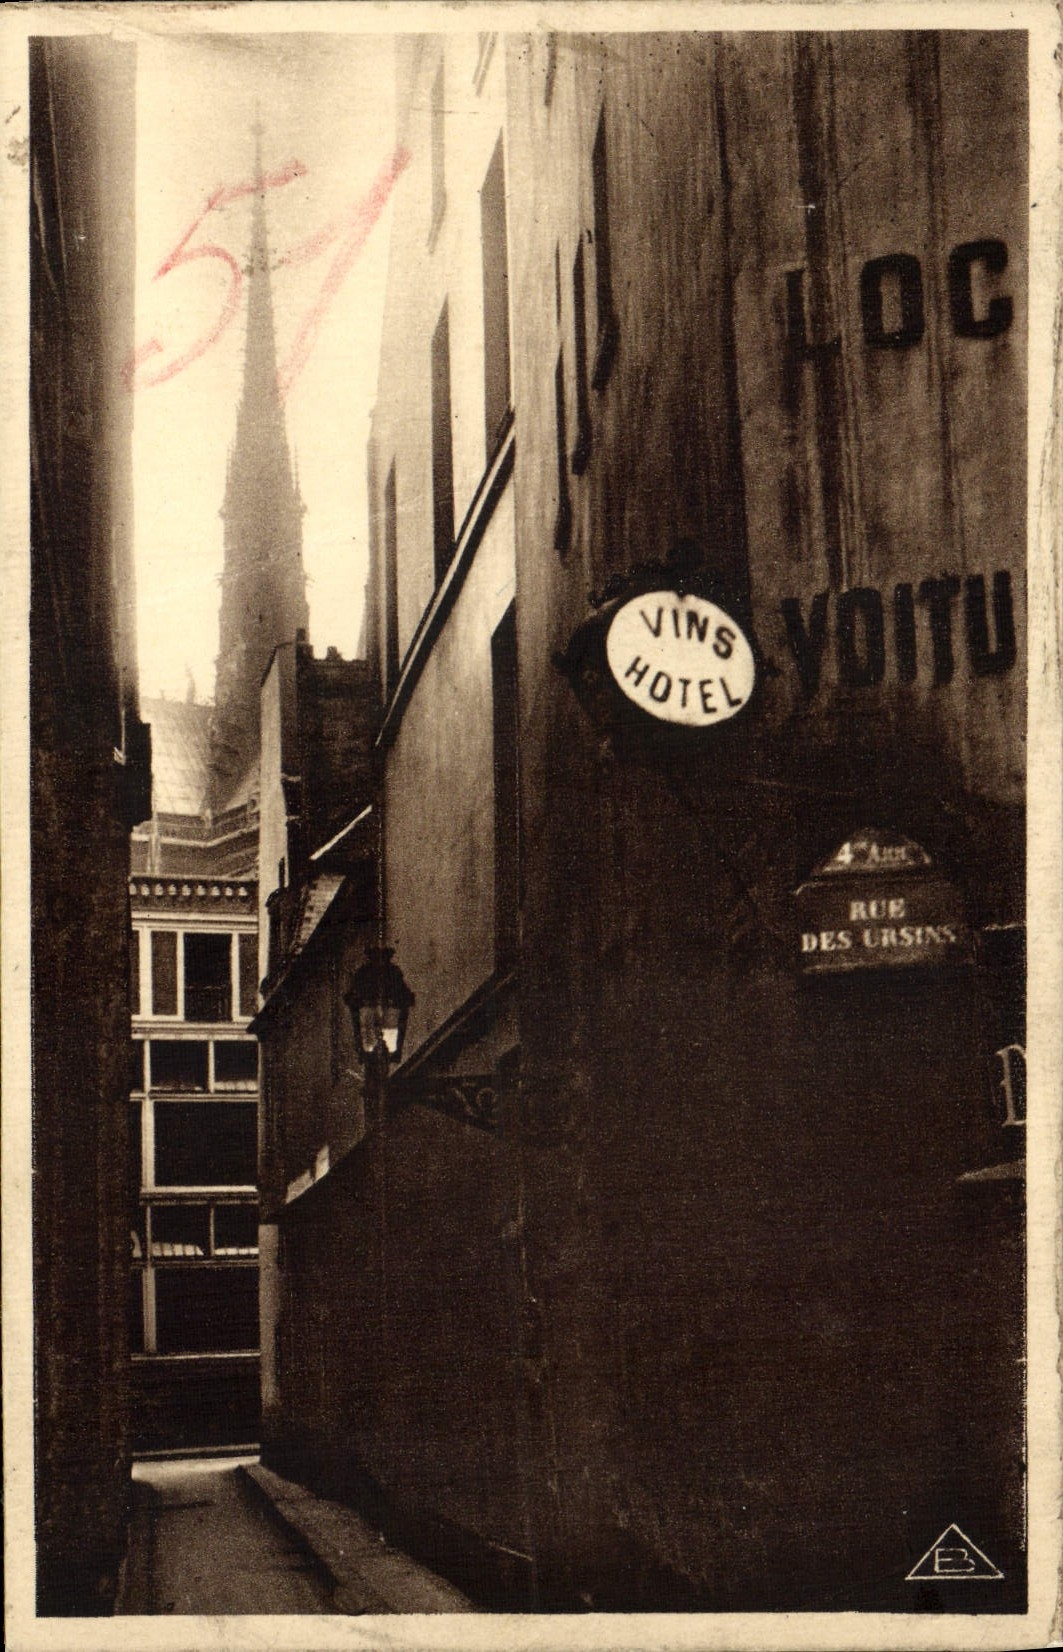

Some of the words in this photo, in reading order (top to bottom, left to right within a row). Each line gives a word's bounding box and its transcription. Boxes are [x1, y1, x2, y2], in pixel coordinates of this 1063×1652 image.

[640, 606, 737, 661] VINS
[781, 569, 1018, 691] VOITU
[624, 656, 743, 714] HOTEL
[848, 897, 906, 922] RUE
[800, 930, 853, 954] DES
[862, 924, 957, 949] URSINS
